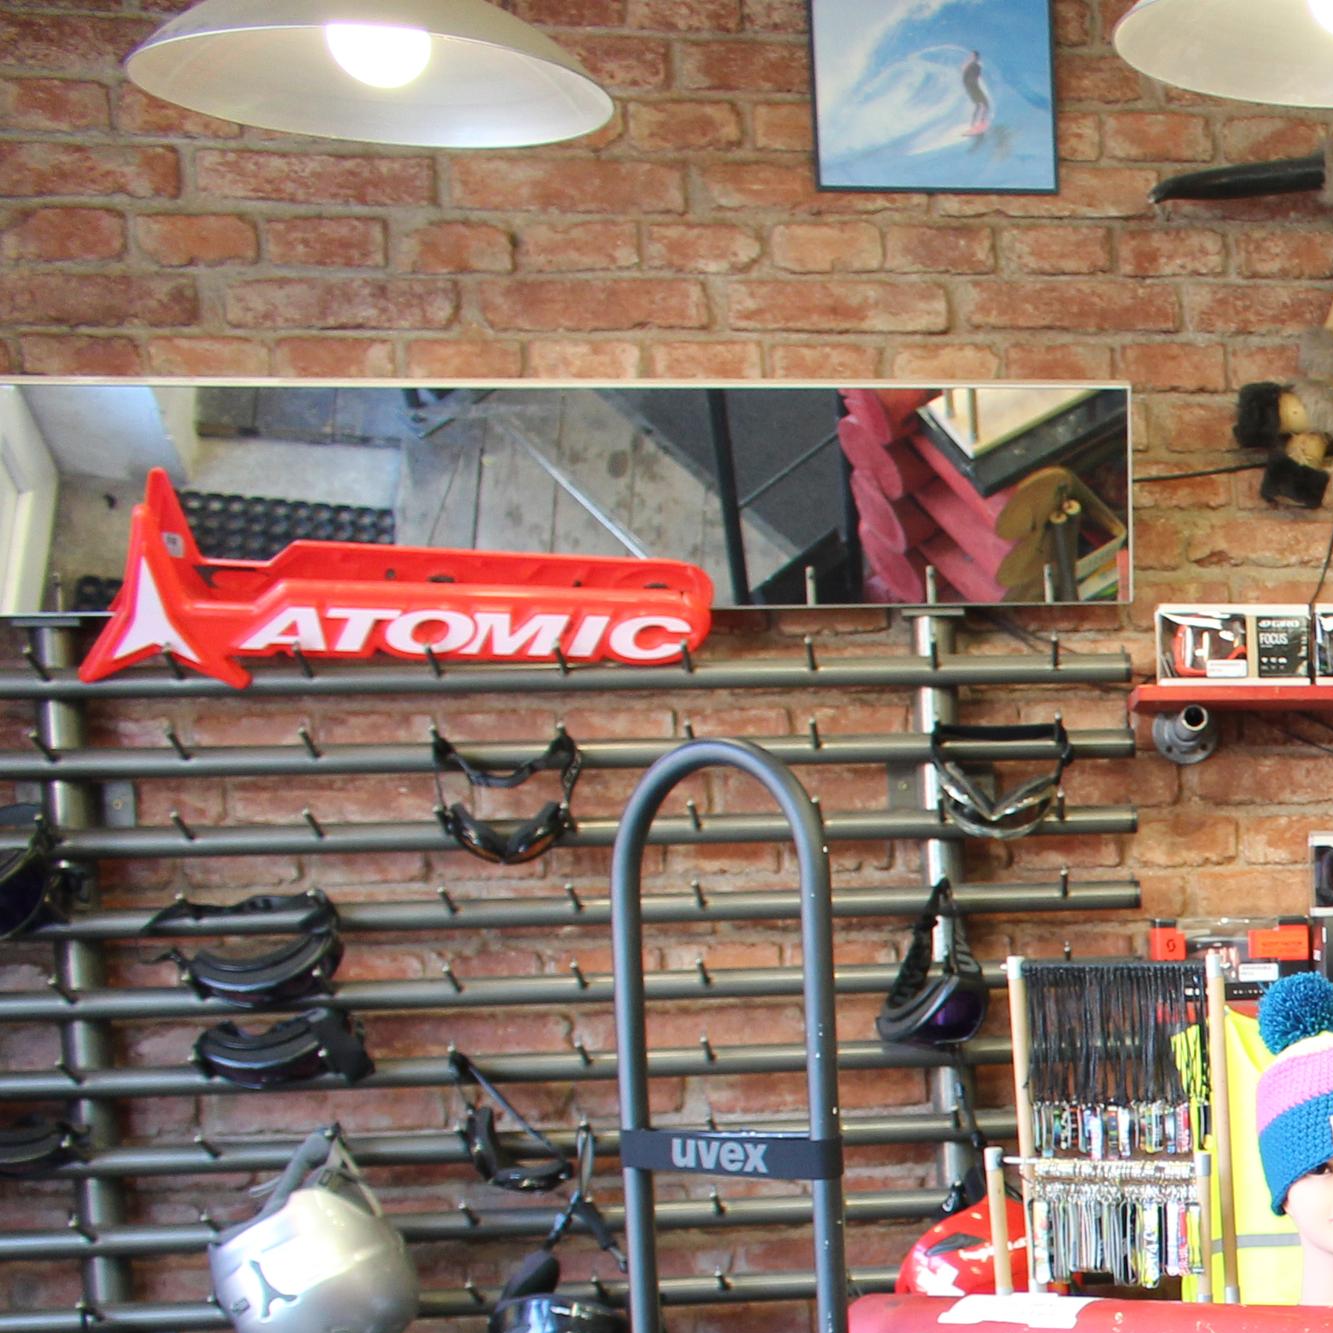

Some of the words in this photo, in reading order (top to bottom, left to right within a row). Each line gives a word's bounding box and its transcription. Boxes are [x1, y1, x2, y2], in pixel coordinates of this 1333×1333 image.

[240, 606, 693, 662] ATOMIC
[1272, 619, 1300, 628] GIRO
[1259, 633, 1288, 645] FOCUS
[671, 1137, 769, 1174] uvex
